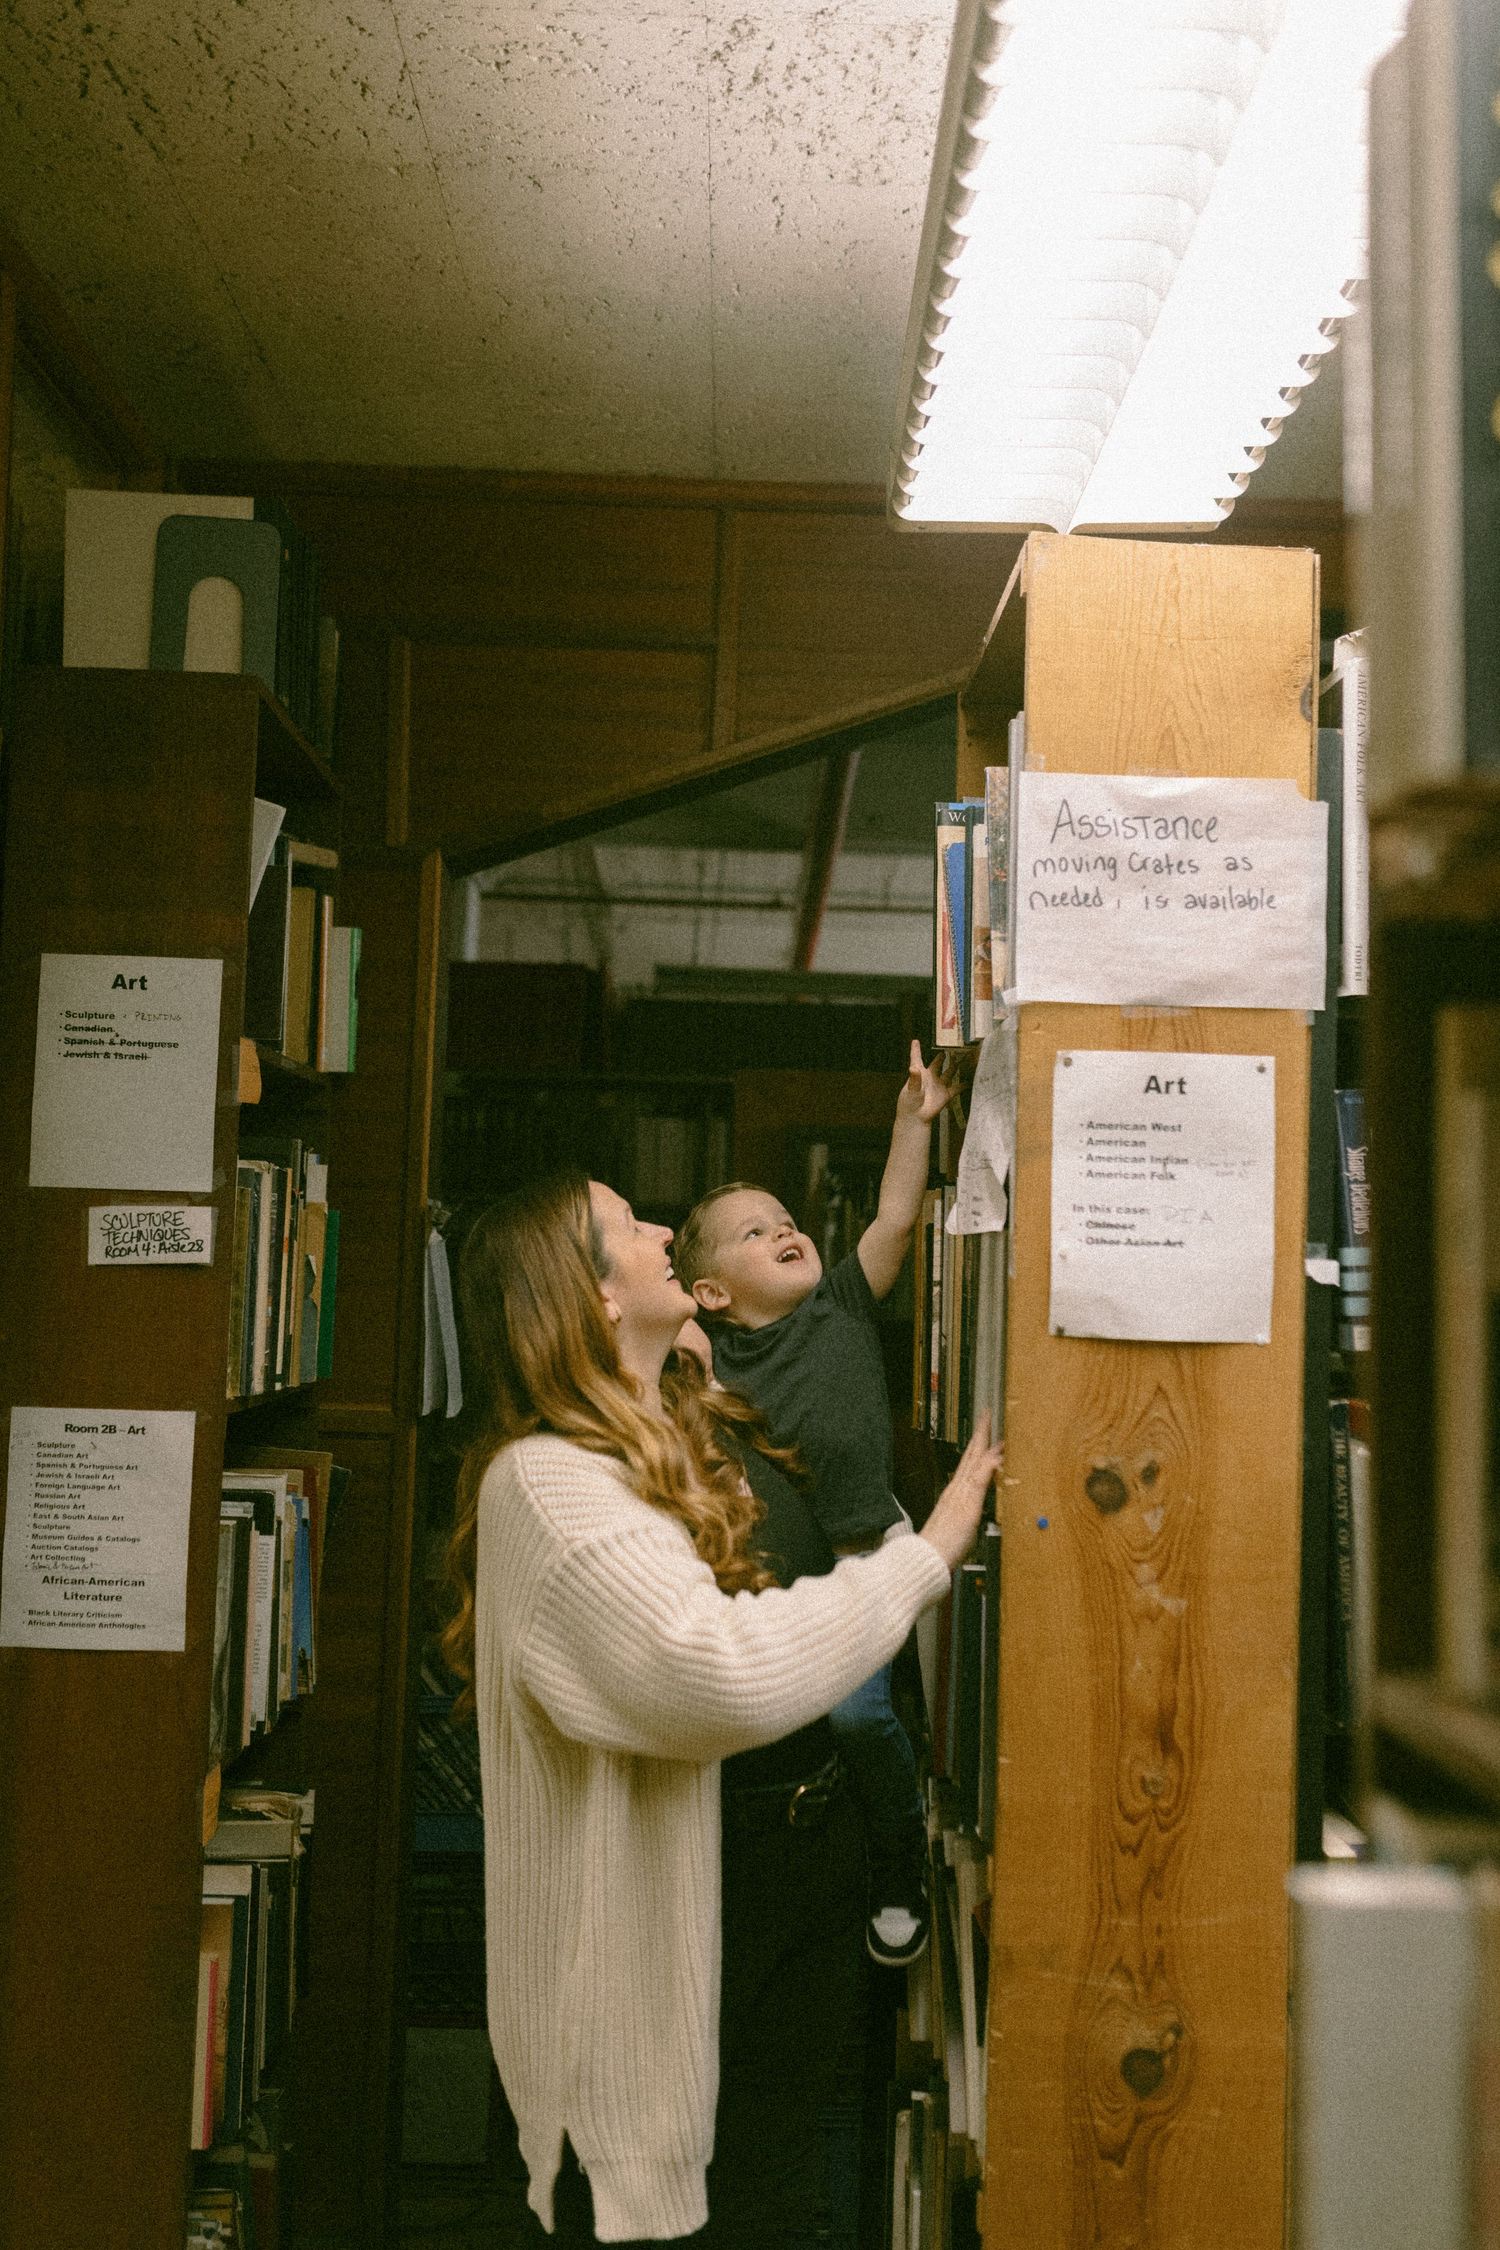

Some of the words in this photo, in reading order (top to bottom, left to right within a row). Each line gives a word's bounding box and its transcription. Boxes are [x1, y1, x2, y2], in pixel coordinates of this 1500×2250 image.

[1050, 798, 1219, 843] Assistance
[1033, 856, 1118, 881] moving
[1128, 851, 1201, 876] Crates
[1225, 856, 1254, 871] as
[1144, 886, 1170, 910] is
[1184, 886, 1278, 911] available
[111, 973, 148, 991] Art
[64, 1010, 116, 1021] Sculpture
[64, 1023, 114, 1033] Canadian
[63, 1037, 105, 1047] Spanish
[108, 1038, 116, 1046] &
[119, 1038, 179, 1050] Portuguese
[62, 1050, 100, 1059] Jewish
[103, 1051, 111, 1059] &
[113, 1051, 149, 1060] Israeli
[1144, 1075, 1188, 1095] Art
[1086, 1120, 1148, 1132] American
[1151, 1122, 1183, 1133] West
[1086, 1136, 1147, 1148] American
[1085, 1153, 1147, 1163] American
[1150, 1155, 1189, 1165] Indian
[1085, 1169, 1146, 1180] American
[1150, 1171, 1177, 1181] Folk
[1072, 1203, 1085, 1212] In
[1088, 1204, 1112, 1213] this
[100, 1210, 185, 1231] SCULPTURE
[102, 1227, 191, 1246] TECHNIQUES
[105, 1244, 140, 1258] ROOM
[64, 1423, 98, 1434] Room
[101, 1424, 117, 1434] 2B
[127, 1425, 146, 1435] Art
[36, 1441, 76, 1450] Sculpture
[35, 1461, 68, 1469] Spanish
[78, 1462, 124, 1471] Portuguese
[35, 1481, 65, 1490] Foreign
[66, 1482, 106, 1491] Language
[33, 1502, 71, 1510] Religious
[32, 1522, 71, 1531] Sculpture
[31, 1533, 65, 1541] Museum
[67, 1533, 95, 1541] Guides
[105, 1535, 141, 1543] Catalogs
[30, 1543, 62, 1551] Auction
[63, 1544, 99, 1553] Catalogs
[45, 1554, 86, 1562] Collecting
[42, 1575, 146, 1587] African-American
[63, 1591, 123, 1602] Literature
[52, 1610, 84, 1618] Literary
[98, 1622, 146, 1630] Anthologies
